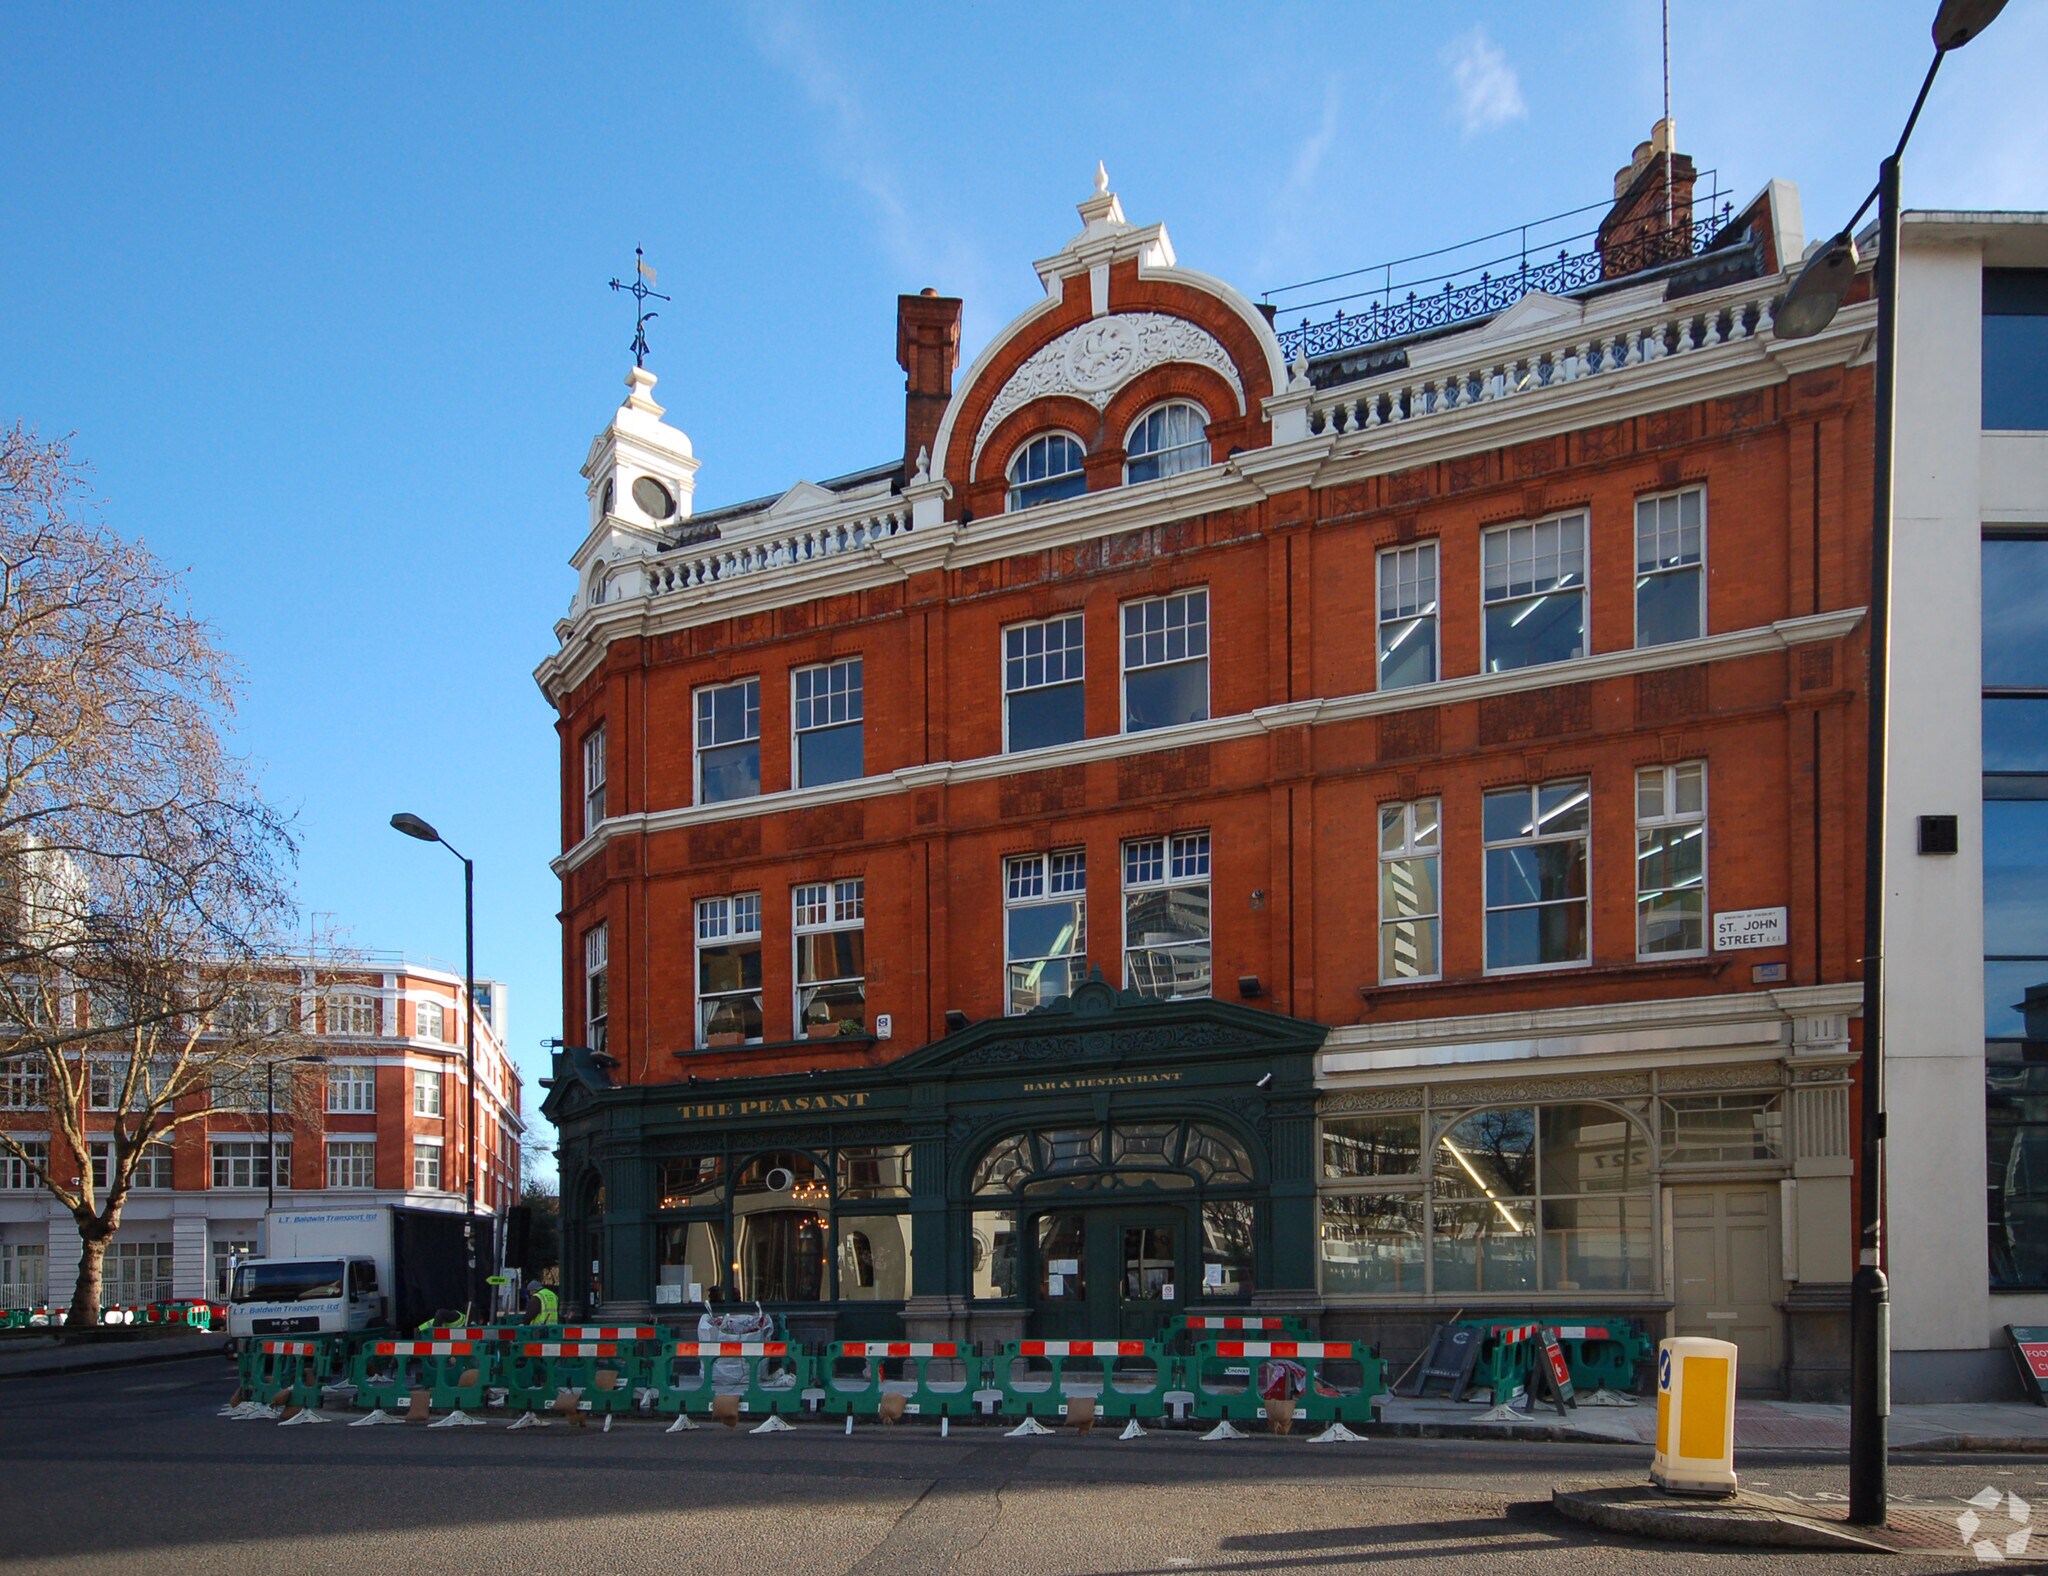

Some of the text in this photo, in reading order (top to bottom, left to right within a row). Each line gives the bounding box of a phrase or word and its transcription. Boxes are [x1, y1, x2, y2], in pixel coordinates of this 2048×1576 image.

[1719, 919, 1778, 933] ST. JOHN
[1719, 933, 1765, 946] STREET
[1023, 1072, 1183, 1092] BAR & RESTAURANT
[677, 1092, 870, 1119] THE PEASANT
[293, 1215, 325, 1223] Baldwin
[326, 1213, 363, 1222] Transport
[249, 1305, 282, 1314] Baldwin
[284, 1303, 324, 1313] Transport
